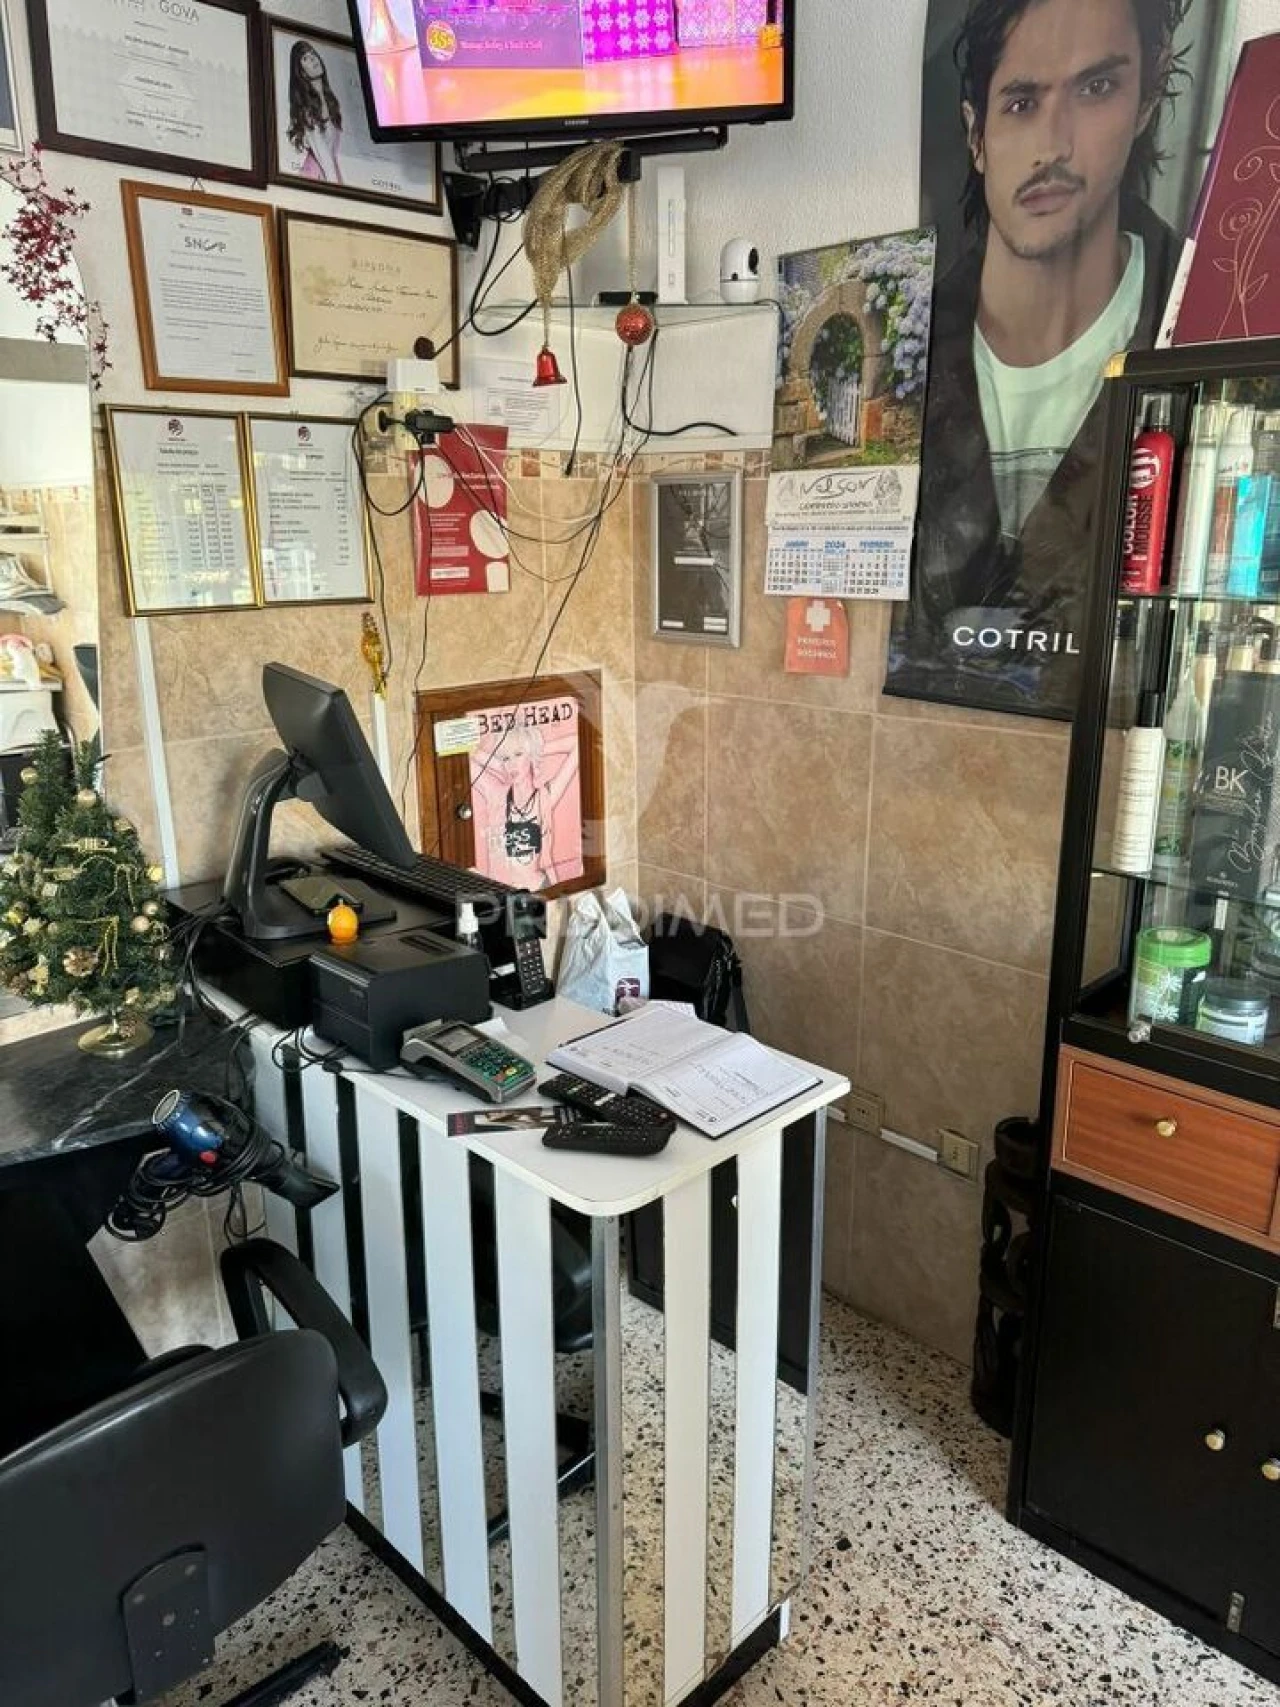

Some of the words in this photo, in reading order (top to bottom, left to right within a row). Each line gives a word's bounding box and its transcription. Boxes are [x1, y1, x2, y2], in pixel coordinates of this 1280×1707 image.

[953, 626, 1080, 654] COTRIL
[478, 712, 515, 735] BED
[523, 703, 573, 727] HEAD
[1215, 766, 1248, 797] BK
